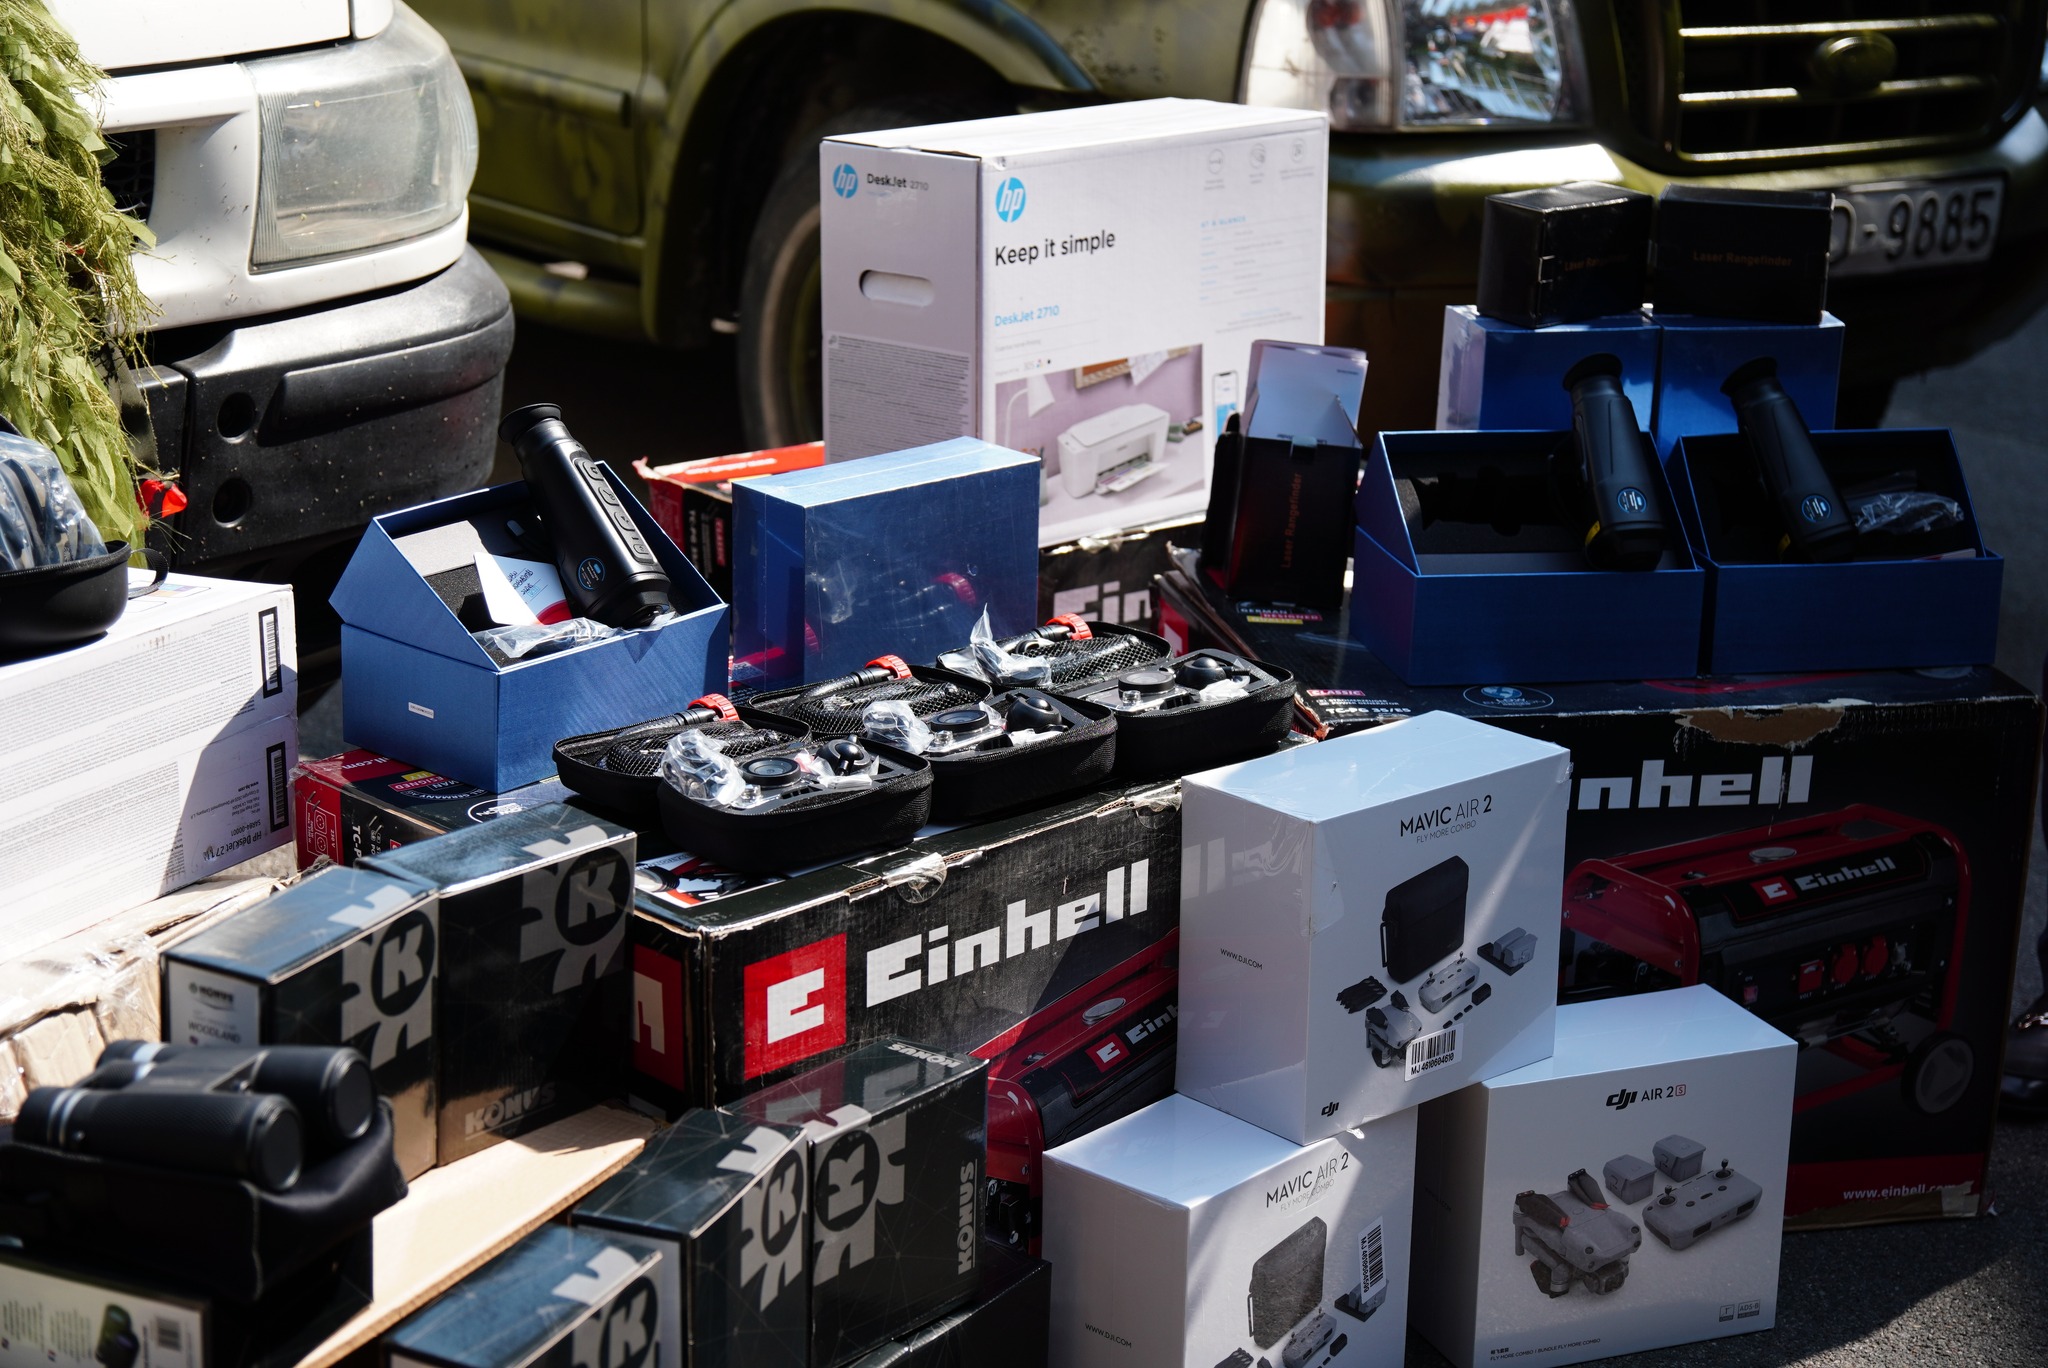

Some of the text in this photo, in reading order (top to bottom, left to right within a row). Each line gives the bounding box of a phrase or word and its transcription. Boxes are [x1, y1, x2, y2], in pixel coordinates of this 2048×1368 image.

[867, 174, 930, 191] DeskJet 2710
[995, 230, 1115, 266] Keep it simple
[1692, 249, 1793, 268] Laser Rangefinder
[995, 305, 1060, 327] DeskJet 2710
[1281, 473, 1303, 568] Laser Rangefinder
[1312, 689, 1363, 697] CLASSIC
[1326, 707, 1369, 715] TC-PG
[1567, 755, 1814, 810] nhell
[1400, 795, 1492, 837] MAVIC AIR 2
[225, 834, 251, 852] DeskJet
[252, 830, 262, 842] HP
[1416, 820, 1477, 843] FLY MORE COMBO
[1793, 856, 1897, 891] Einhell
[866, 858, 1149, 1008] Einhell
[1220, 948, 1263, 970] WWW.DJI.COM
[188, 1021, 241, 1044] WOODLAND
[887, 1042, 961, 1068] KONUS
[1410, 1064, 1421, 1075] MJ
[1641, 1087, 1663, 1102] AIR
[465, 1081, 557, 1135] KONUS
[1266, 1152, 1349, 1208] MAVIC AIR 2
[957, 1161, 975, 1275] KONUS
[1360, 1236, 1367, 1250] MJ
[1085, 1322, 1132, 1348] WWW.DJI.COM
[1537, 1345, 1557, 1353] BUNDLE
